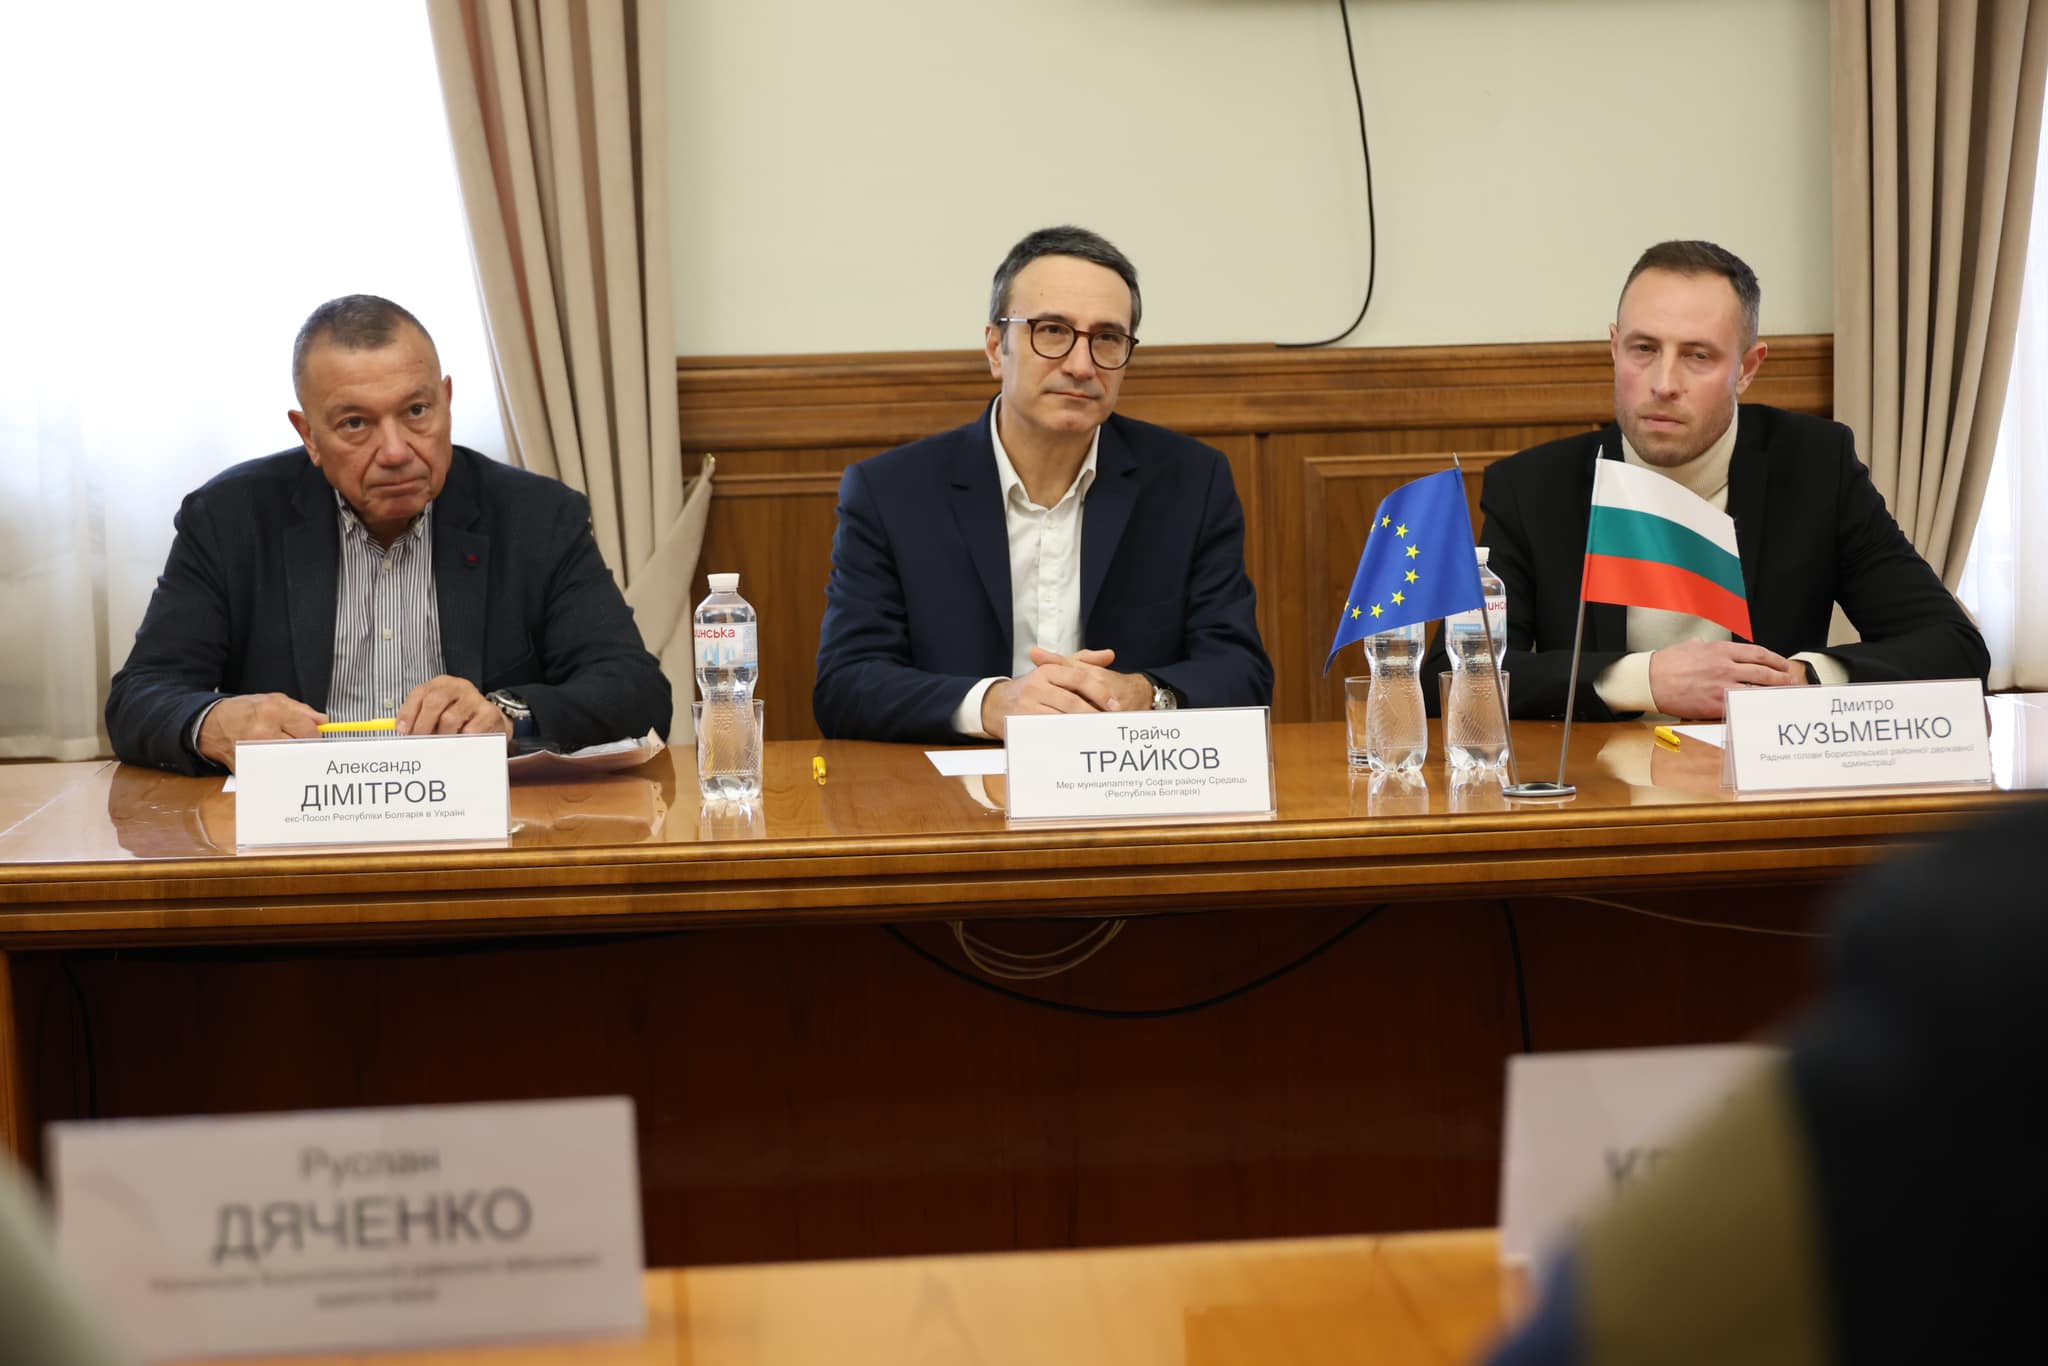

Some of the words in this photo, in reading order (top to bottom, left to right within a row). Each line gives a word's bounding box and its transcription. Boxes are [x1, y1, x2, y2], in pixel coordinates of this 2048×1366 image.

[1831, 698, 1894, 716] Дмитро
[1117, 726, 1181, 744] Трайчо
[1777, 716, 1952, 746] КУЗЬМЕНКО
[326, 759, 422, 775] Александр
[1080, 744, 1220, 773] ТРАЙКОВ
[1056, 780, 1075, 790] Мер
[1158, 787, 1201, 798] Болгарія)
[300, 780, 447, 811] ДІМІТРОВ
[284, 813, 330, 824] екс-Посол
[433, 808, 466, 819] Україні
[299, 1143, 440, 1187] Руслан
[212, 1186, 534, 1264] ДЯЧЕНКО
